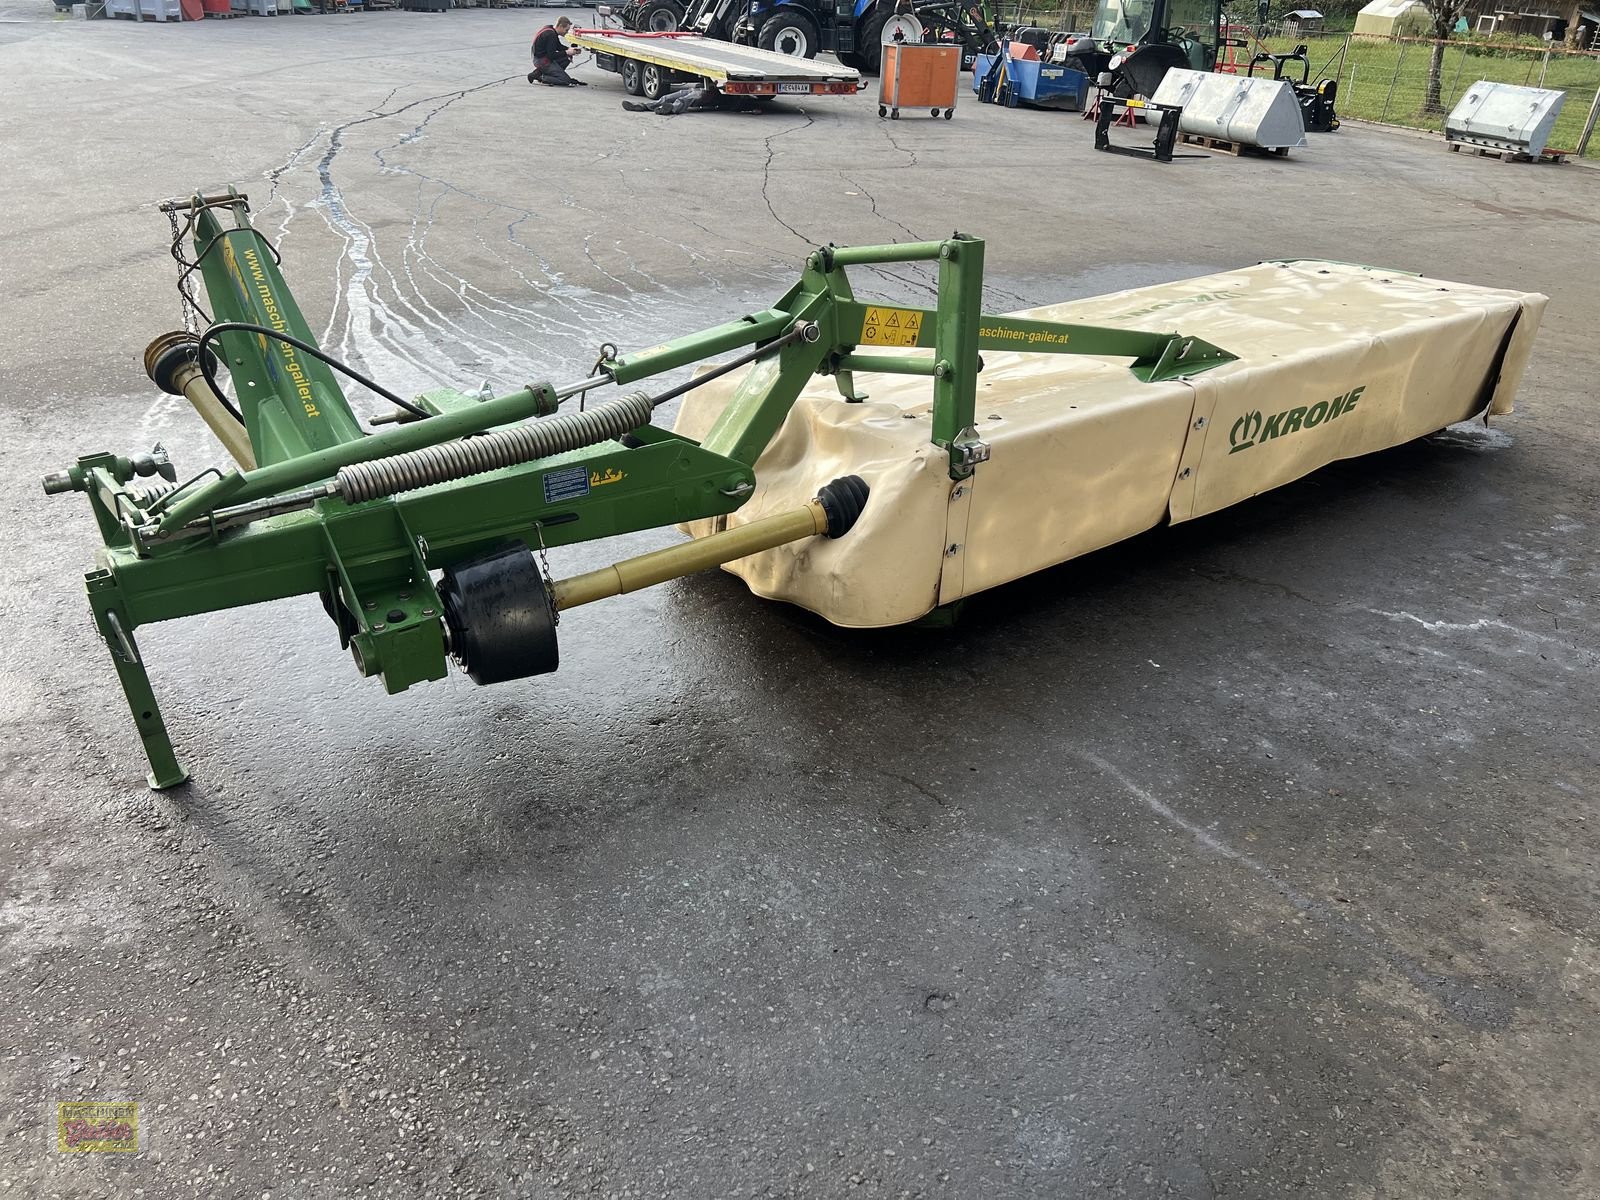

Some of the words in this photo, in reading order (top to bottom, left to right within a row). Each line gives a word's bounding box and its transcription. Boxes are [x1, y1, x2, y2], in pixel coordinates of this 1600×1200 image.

[244, 249, 321, 419] www.maschien-gailer.at
[979, 325, 1069, 344] aschinen-gailer.at
[1258, 385, 1366, 444] KRONE
